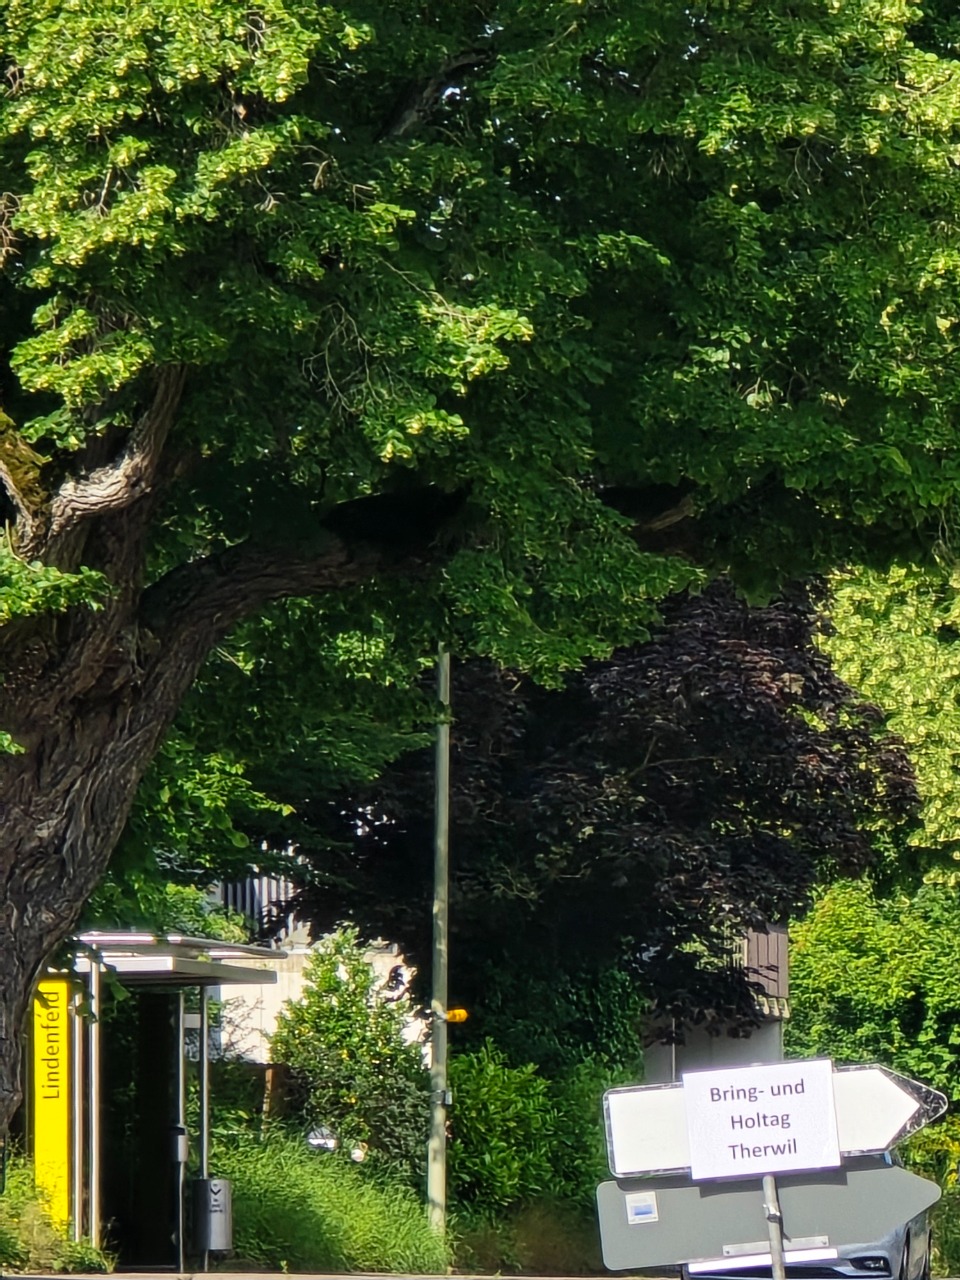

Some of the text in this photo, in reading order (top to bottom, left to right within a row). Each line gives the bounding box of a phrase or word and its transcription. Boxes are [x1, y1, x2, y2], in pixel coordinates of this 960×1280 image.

[710, 1078, 805, 1102] Bring- und
[730, 1112, 791, 1130] Holtag
[728, 1138, 797, 1160] Therwil
